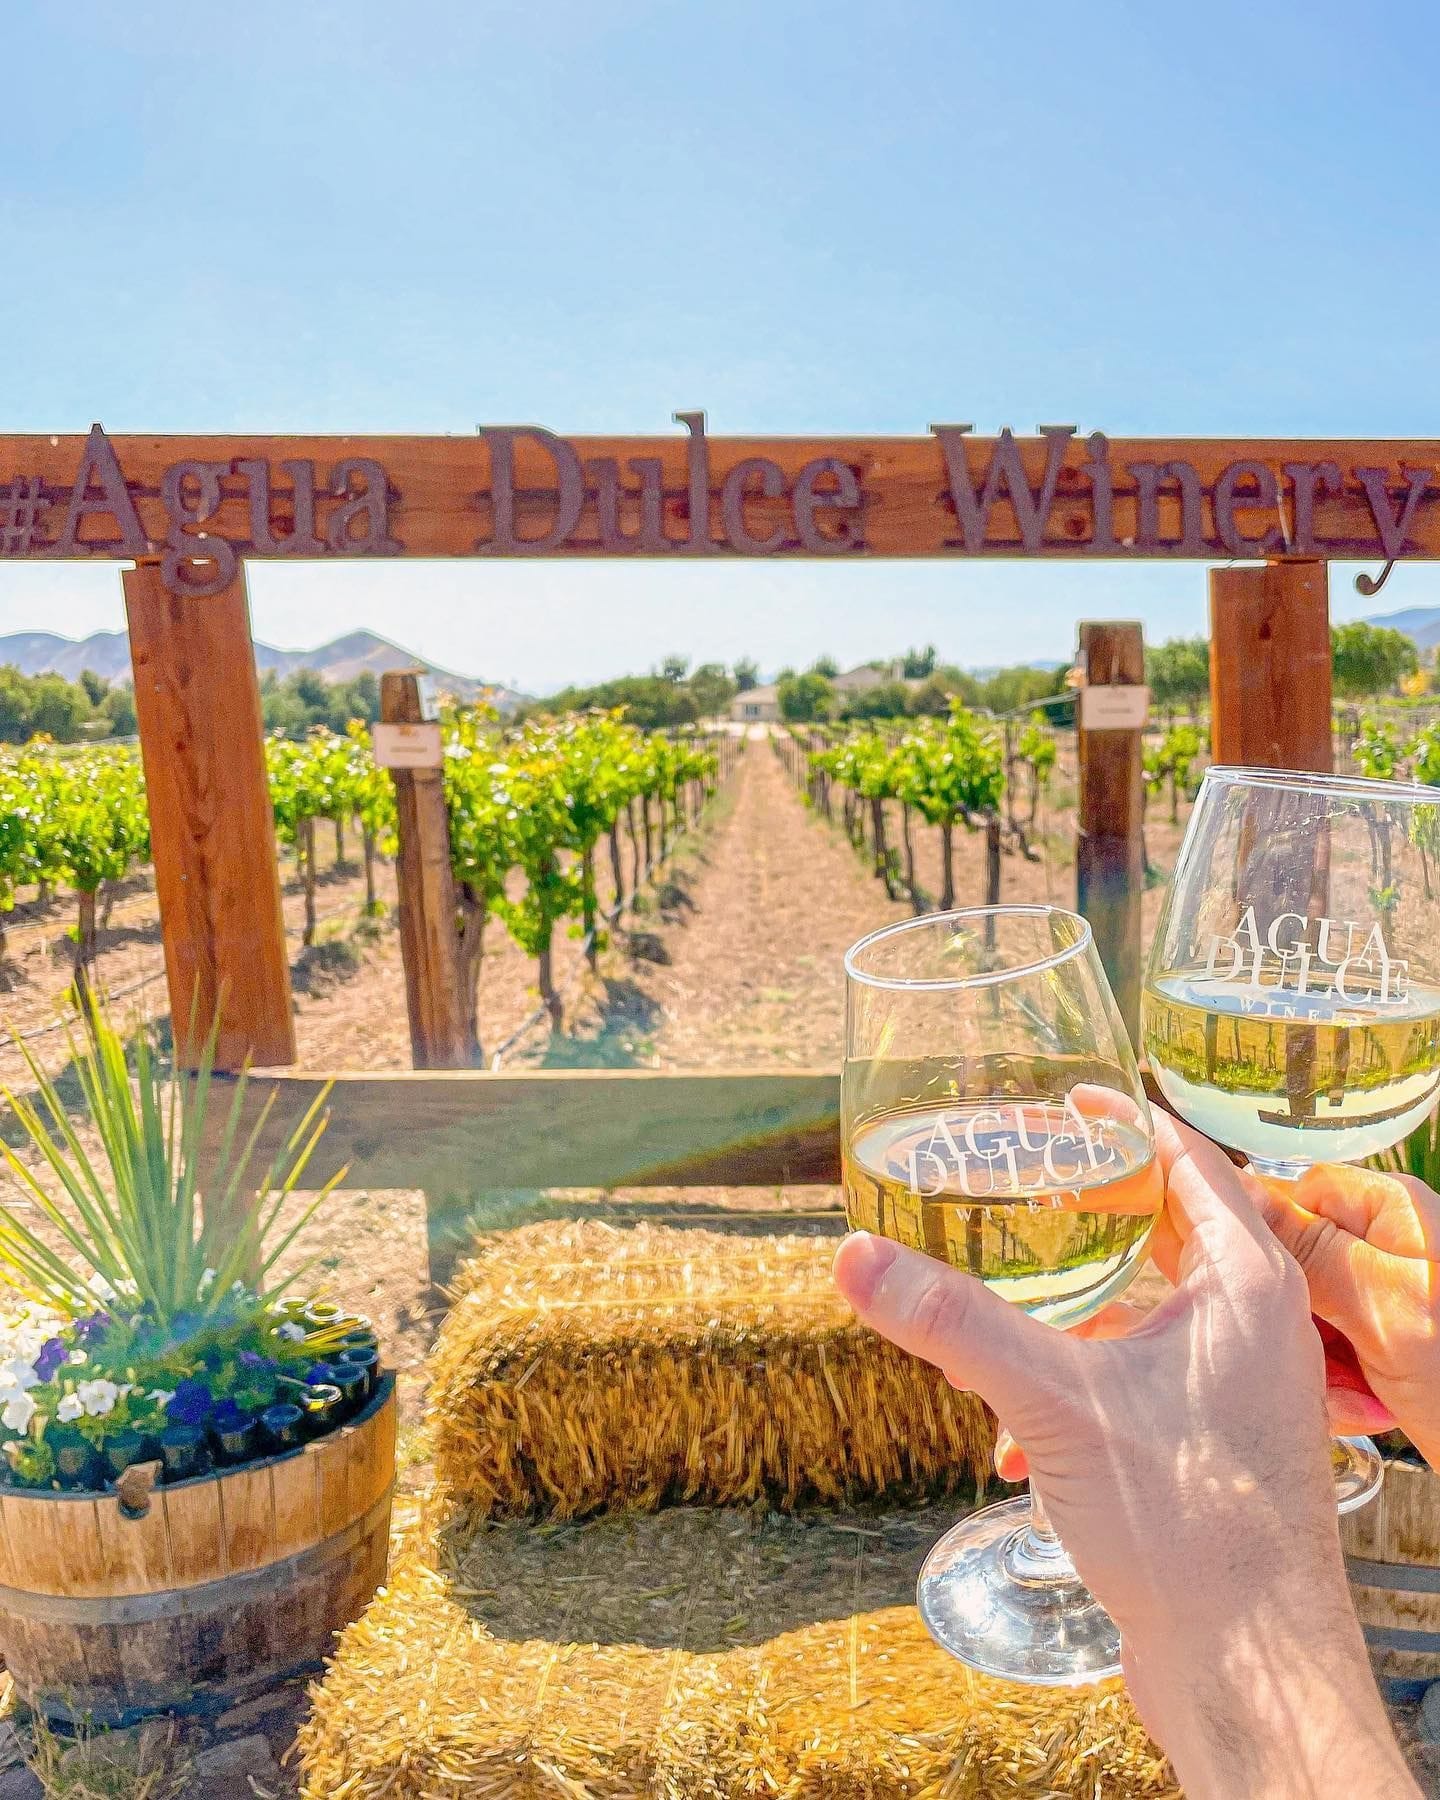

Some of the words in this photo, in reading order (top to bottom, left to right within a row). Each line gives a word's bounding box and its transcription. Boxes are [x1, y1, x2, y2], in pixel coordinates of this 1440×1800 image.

[477, 410, 864, 554] Dulce
[930, 424, 1434, 596] Winery
[1203, 934, 1410, 1005] DULCE
[1227, 905, 1393, 968] AGUA
[1239, 997, 1352, 1025] WINE
[904, 1118, 1116, 1198] DULCE
[925, 1093, 1095, 1162] AGUA
[956, 1186, 1082, 1222] WINERY
